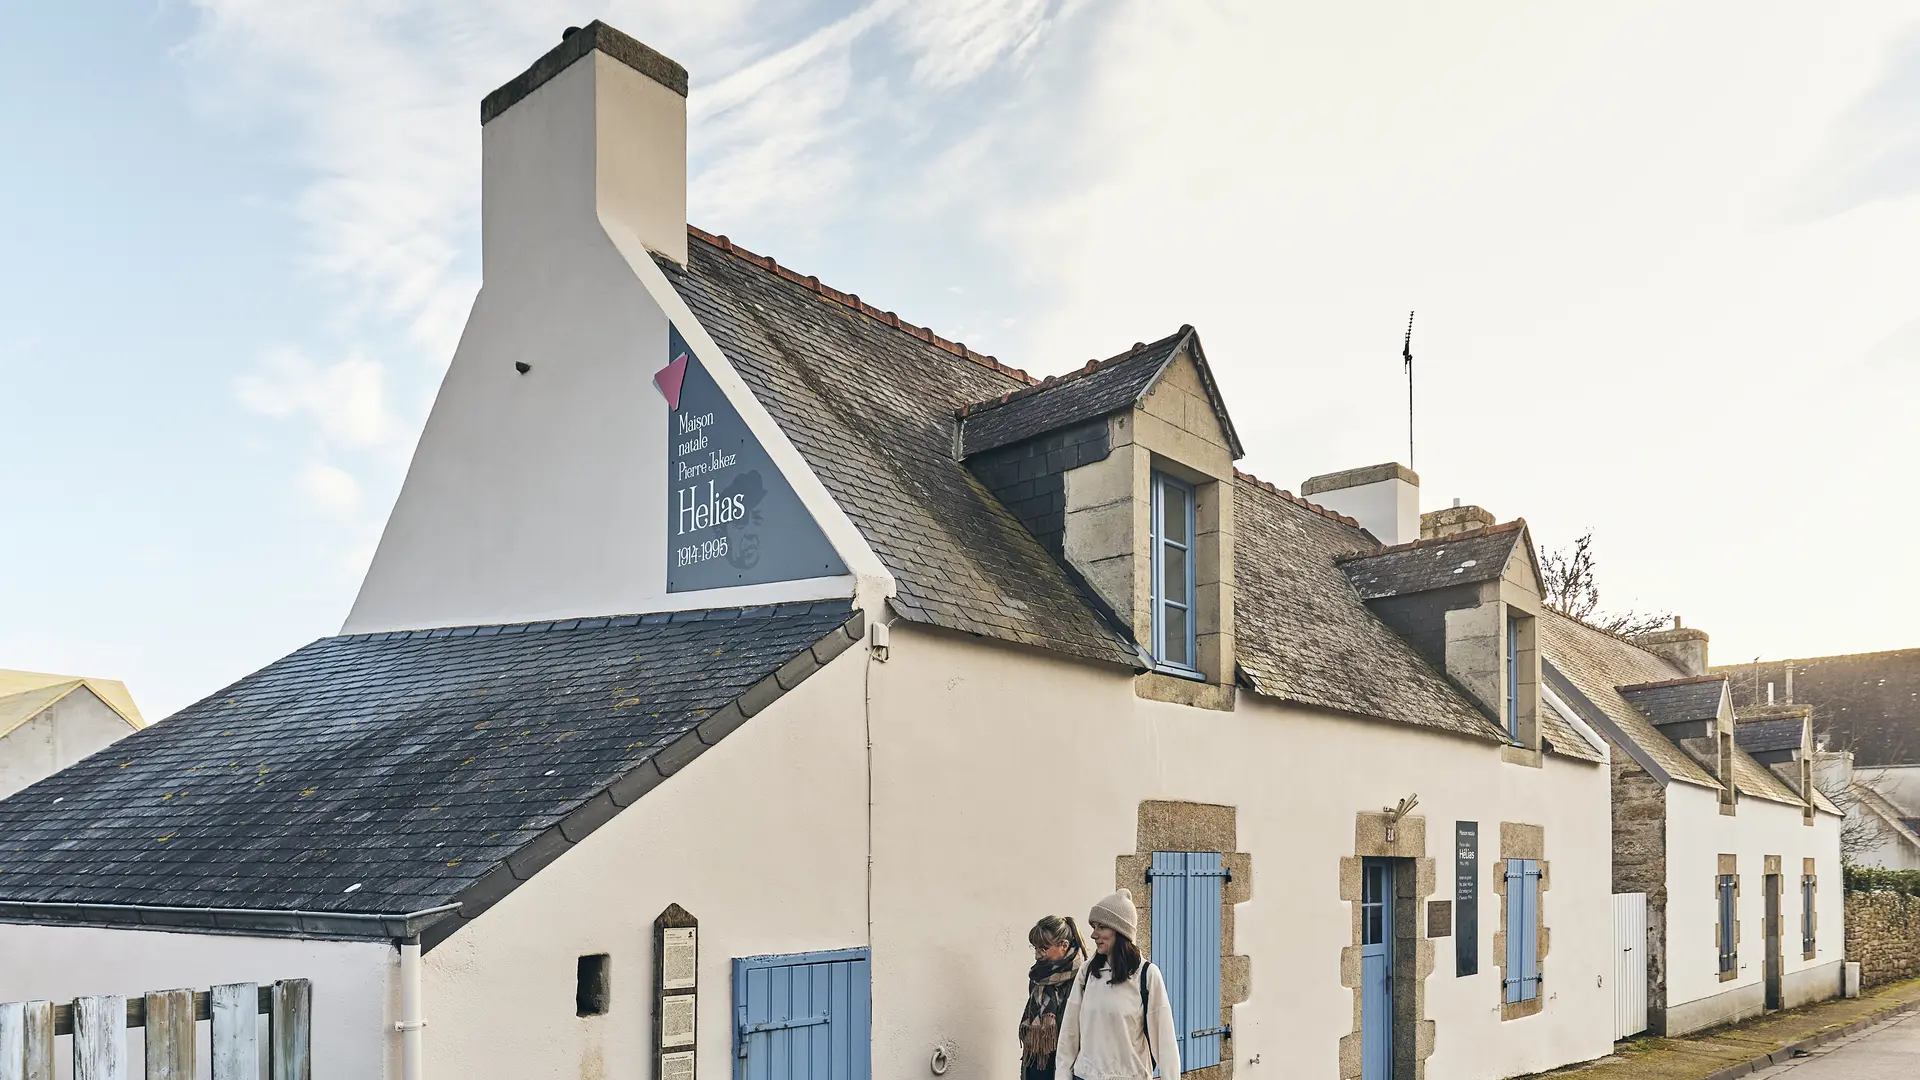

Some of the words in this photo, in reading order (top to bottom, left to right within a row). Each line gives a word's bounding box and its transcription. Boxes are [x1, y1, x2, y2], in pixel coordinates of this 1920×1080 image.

[678, 412, 714, 435] Maison
[678, 430, 708, 456] natale
[678, 460, 706, 481] Pierre
[708, 450, 736, 472] Jakez
[677, 479, 745, 535] Helias
[677, 537, 728, 567] 1914-1995
